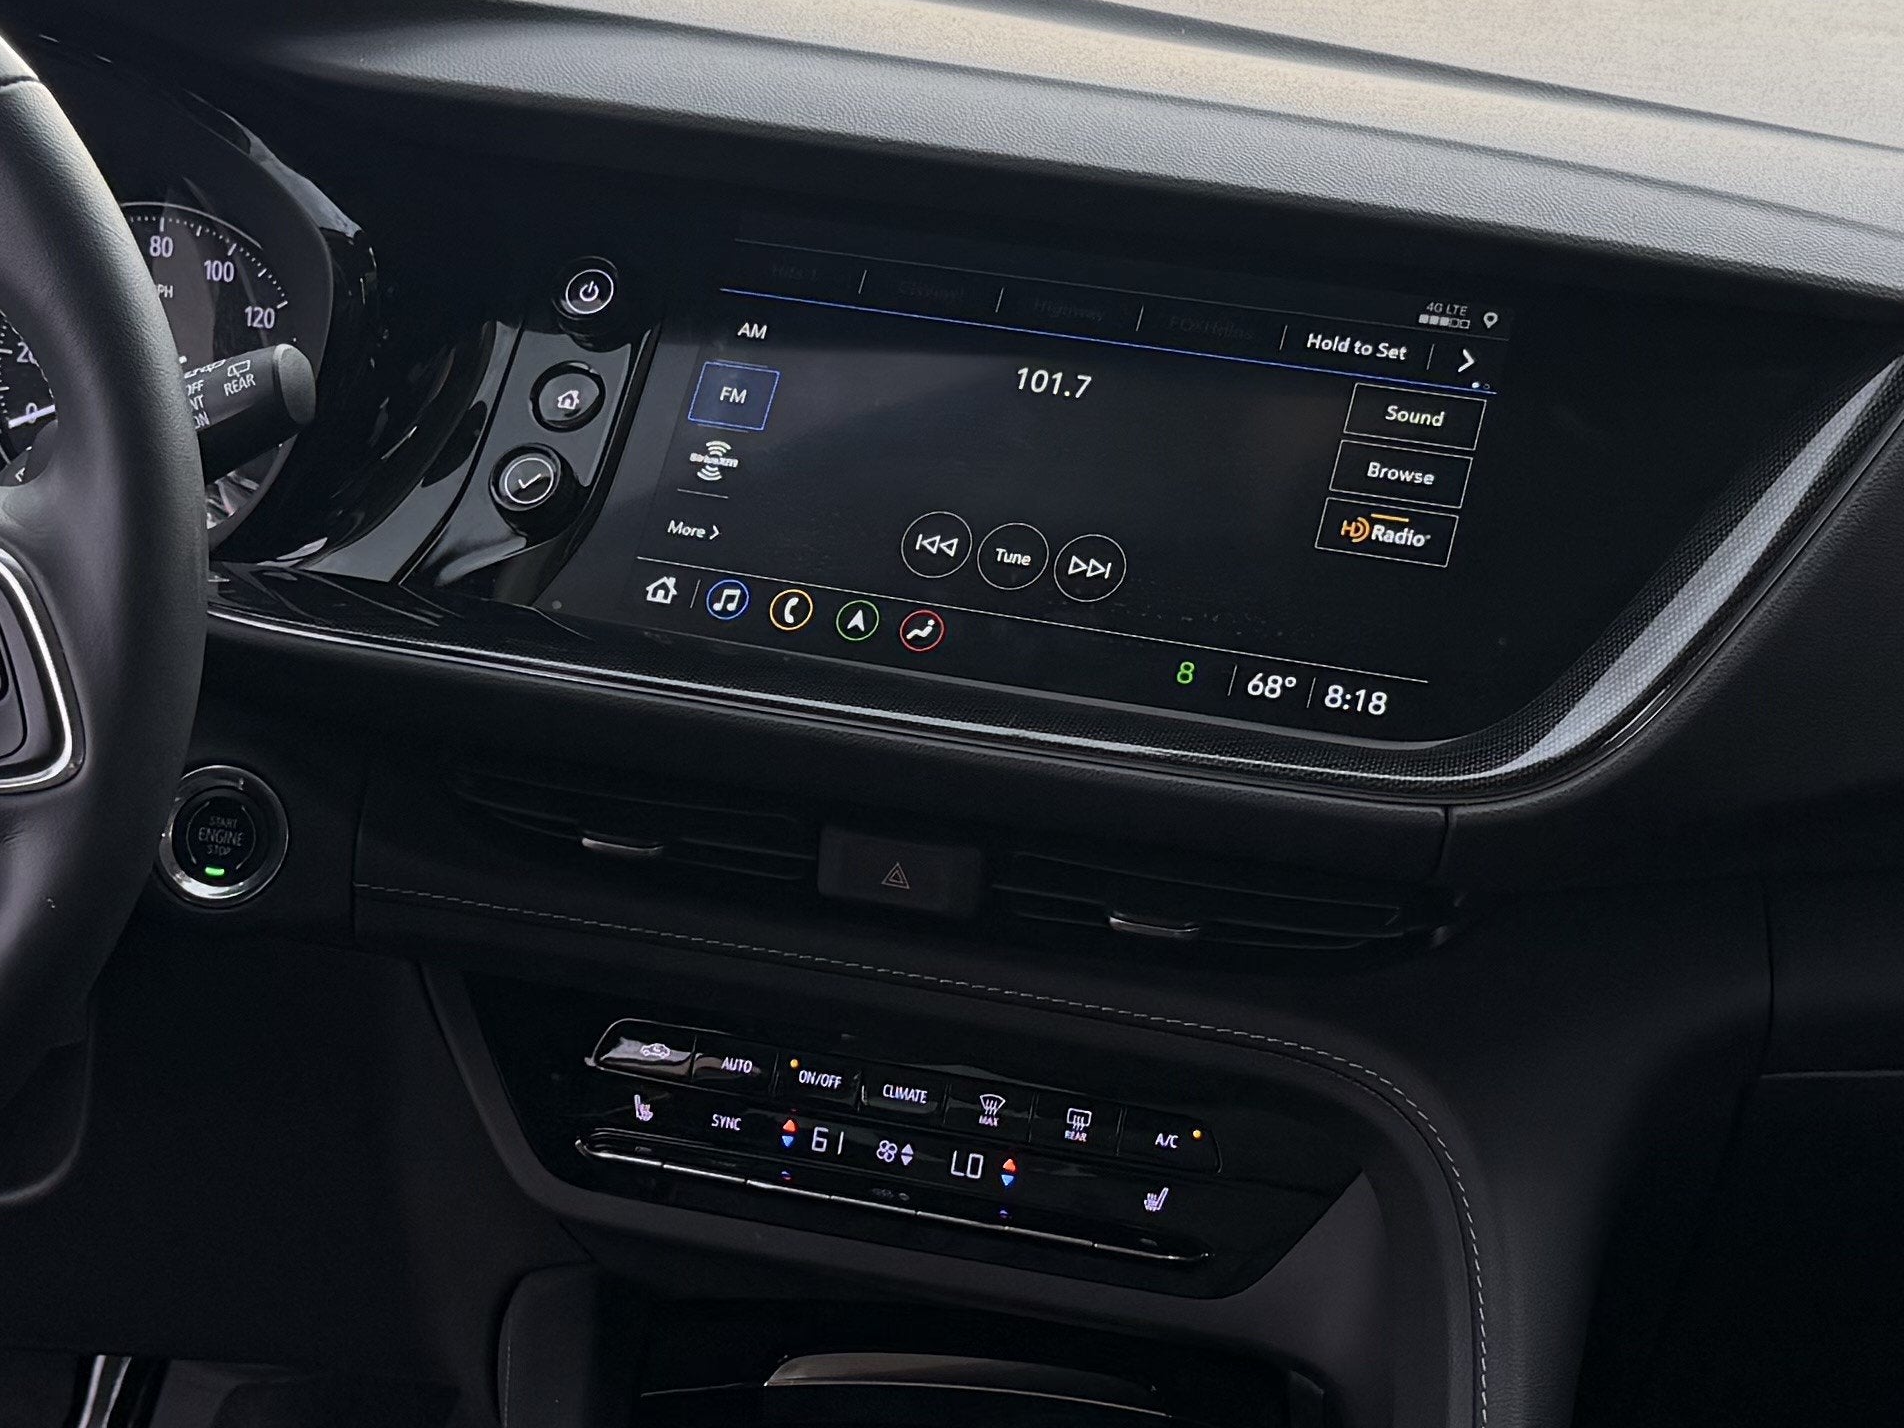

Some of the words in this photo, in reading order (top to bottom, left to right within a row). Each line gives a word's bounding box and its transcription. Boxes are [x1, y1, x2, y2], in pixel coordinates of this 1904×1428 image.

[149, 236, 174, 258] 80
[203, 259, 235, 284] 100
[244, 305, 276, 330] 120
[1426, 301, 1444, 314] 4G
[1446, 303, 1469, 317] LTE
[737, 321, 768, 341] AM
[1306, 332, 1351, 354] Hold
[1353, 340, 1373, 356] to
[1376, 342, 1408, 361] Set
[223, 373, 256, 397] REAR
[1015, 366, 1093, 400] 101.7
[718, 385, 748, 406] FM
[1384, 404, 1446, 428] Sound
[1366, 461, 1436, 486] Browse
[666, 519, 706, 541] More
[1371, 523, 1428, 548] Radio
[995, 547, 1033, 568] Tune
[1175, 660, 1196, 686] 8
[1246, 671, 1297, 701] 68°
[1322, 684, 1389, 717] 8:18
[208, 815, 239, 830] START
[198, 826, 244, 848] ENGINE
[206, 843, 232, 857] STOP
[720, 1056, 753, 1074] AUTO
[798, 1069, 843, 1090] ON/OFF
[882, 1083, 928, 1105] CLIMATE
[711, 1113, 743, 1132] SYNC
[978, 1114, 1000, 1128] MAX
[811, 1126, 845, 1155] 61
[1064, 1129, 1088, 1143] REAR
[1154, 1133, 1180, 1150] A/C
[950, 1149, 985, 1179] LO
